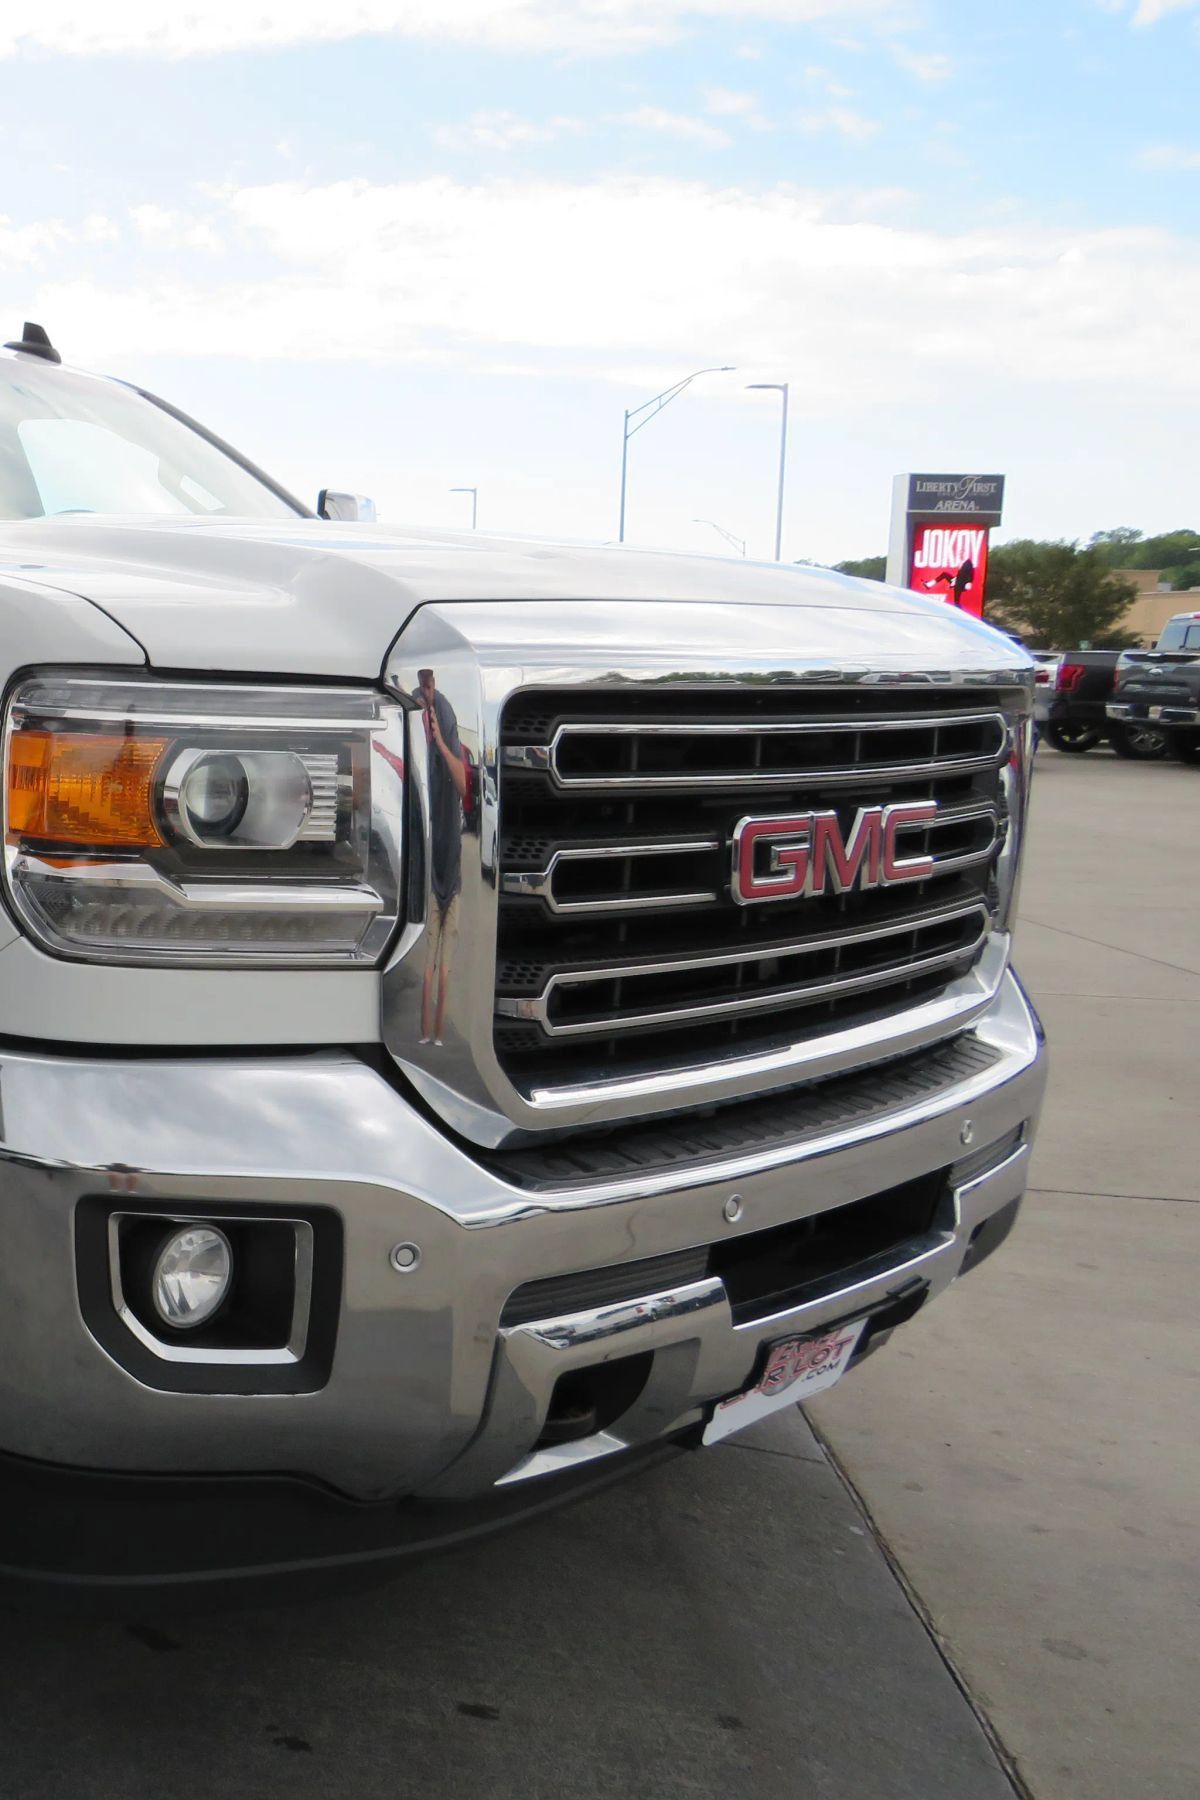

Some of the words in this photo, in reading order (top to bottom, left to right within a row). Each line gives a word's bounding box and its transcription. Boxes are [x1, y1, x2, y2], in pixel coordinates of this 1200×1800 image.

[916, 480, 959, 493] LIBERTY
[956, 475, 998, 499] FIRST
[933, 500, 976, 511] ARENA
[731, 800, 938, 906] GMC
